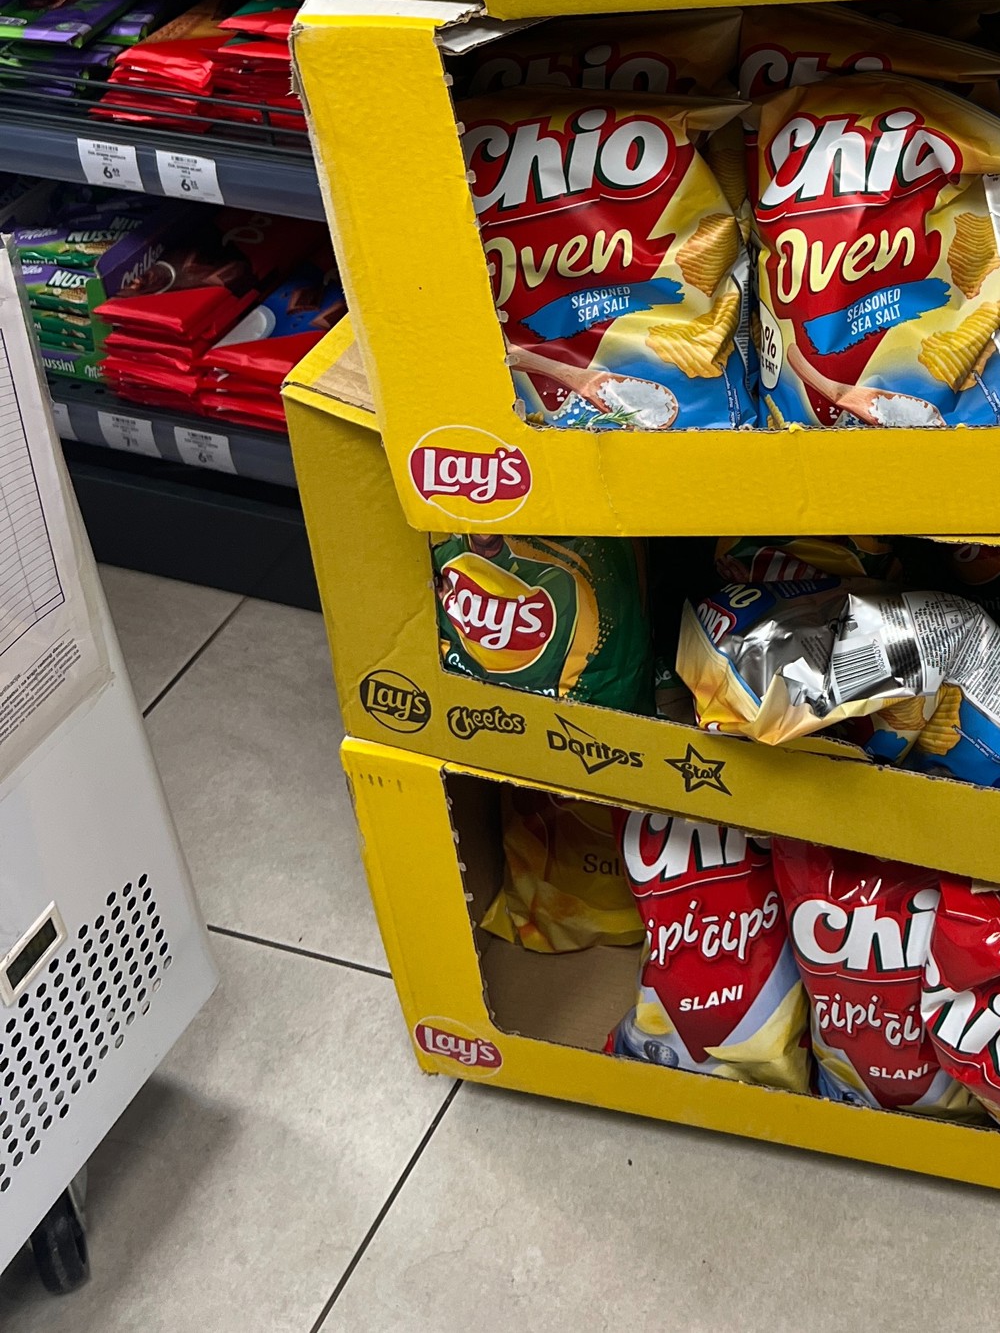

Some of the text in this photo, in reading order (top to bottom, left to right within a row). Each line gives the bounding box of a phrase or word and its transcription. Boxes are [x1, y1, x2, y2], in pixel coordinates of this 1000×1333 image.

[104, 166, 113, 179] 6
[468, 107, 669, 212] Chio
[760, 109, 956, 210] Chio
[181, 178, 190, 192] 6
[774, 228, 914, 305] Oven
[571, 286, 631, 308] SEASONED
[578, 296, 631, 323] SEA SALT
[846, 287, 902, 323] SEASONED
[850, 304, 902, 336] SEA SALT
[422, 447, 524, 503] Lay's
[366, 680, 427, 721] Lay's
[447, 705, 526, 740] Cheetos
[547, 729, 644, 768] Doritos
[791, 888, 940, 971] Chi
[679, 984, 744, 1012] SLANI
[424, 1023, 495, 1066] Lay's
